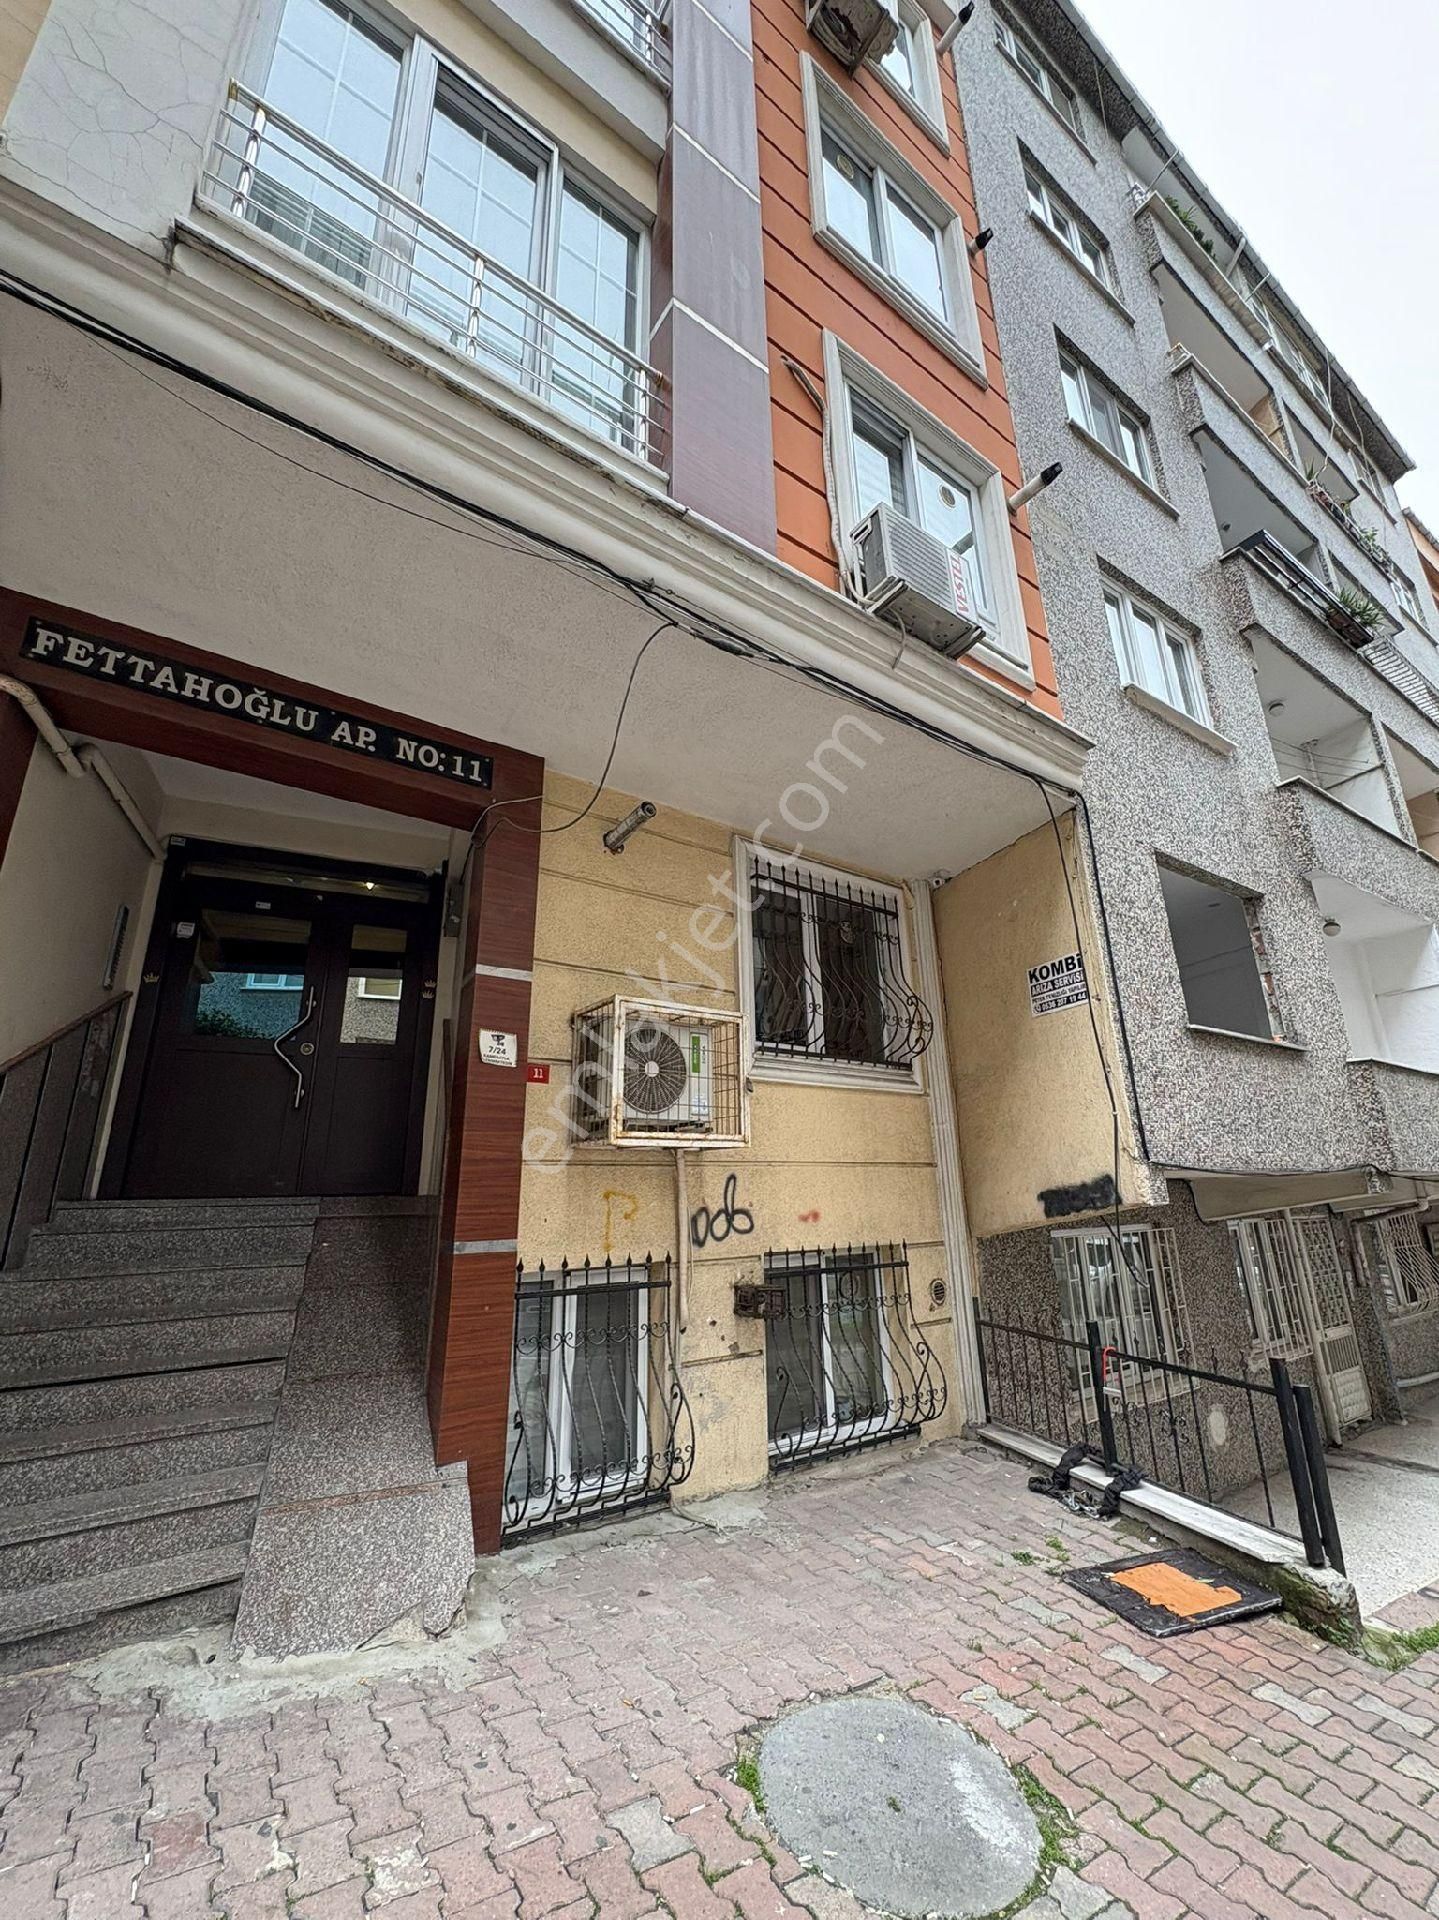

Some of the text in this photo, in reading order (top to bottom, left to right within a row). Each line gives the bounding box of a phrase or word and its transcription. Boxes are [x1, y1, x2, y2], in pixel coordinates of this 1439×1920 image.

[31, 628, 318, 732] FETTAHOĞLU
[331, 721, 377, 752] AP.
[1031, 981, 1054, 996] ARIZA
[489, 1046, 507, 1055] 7/24
[533, 1068, 544, 1079] 11
